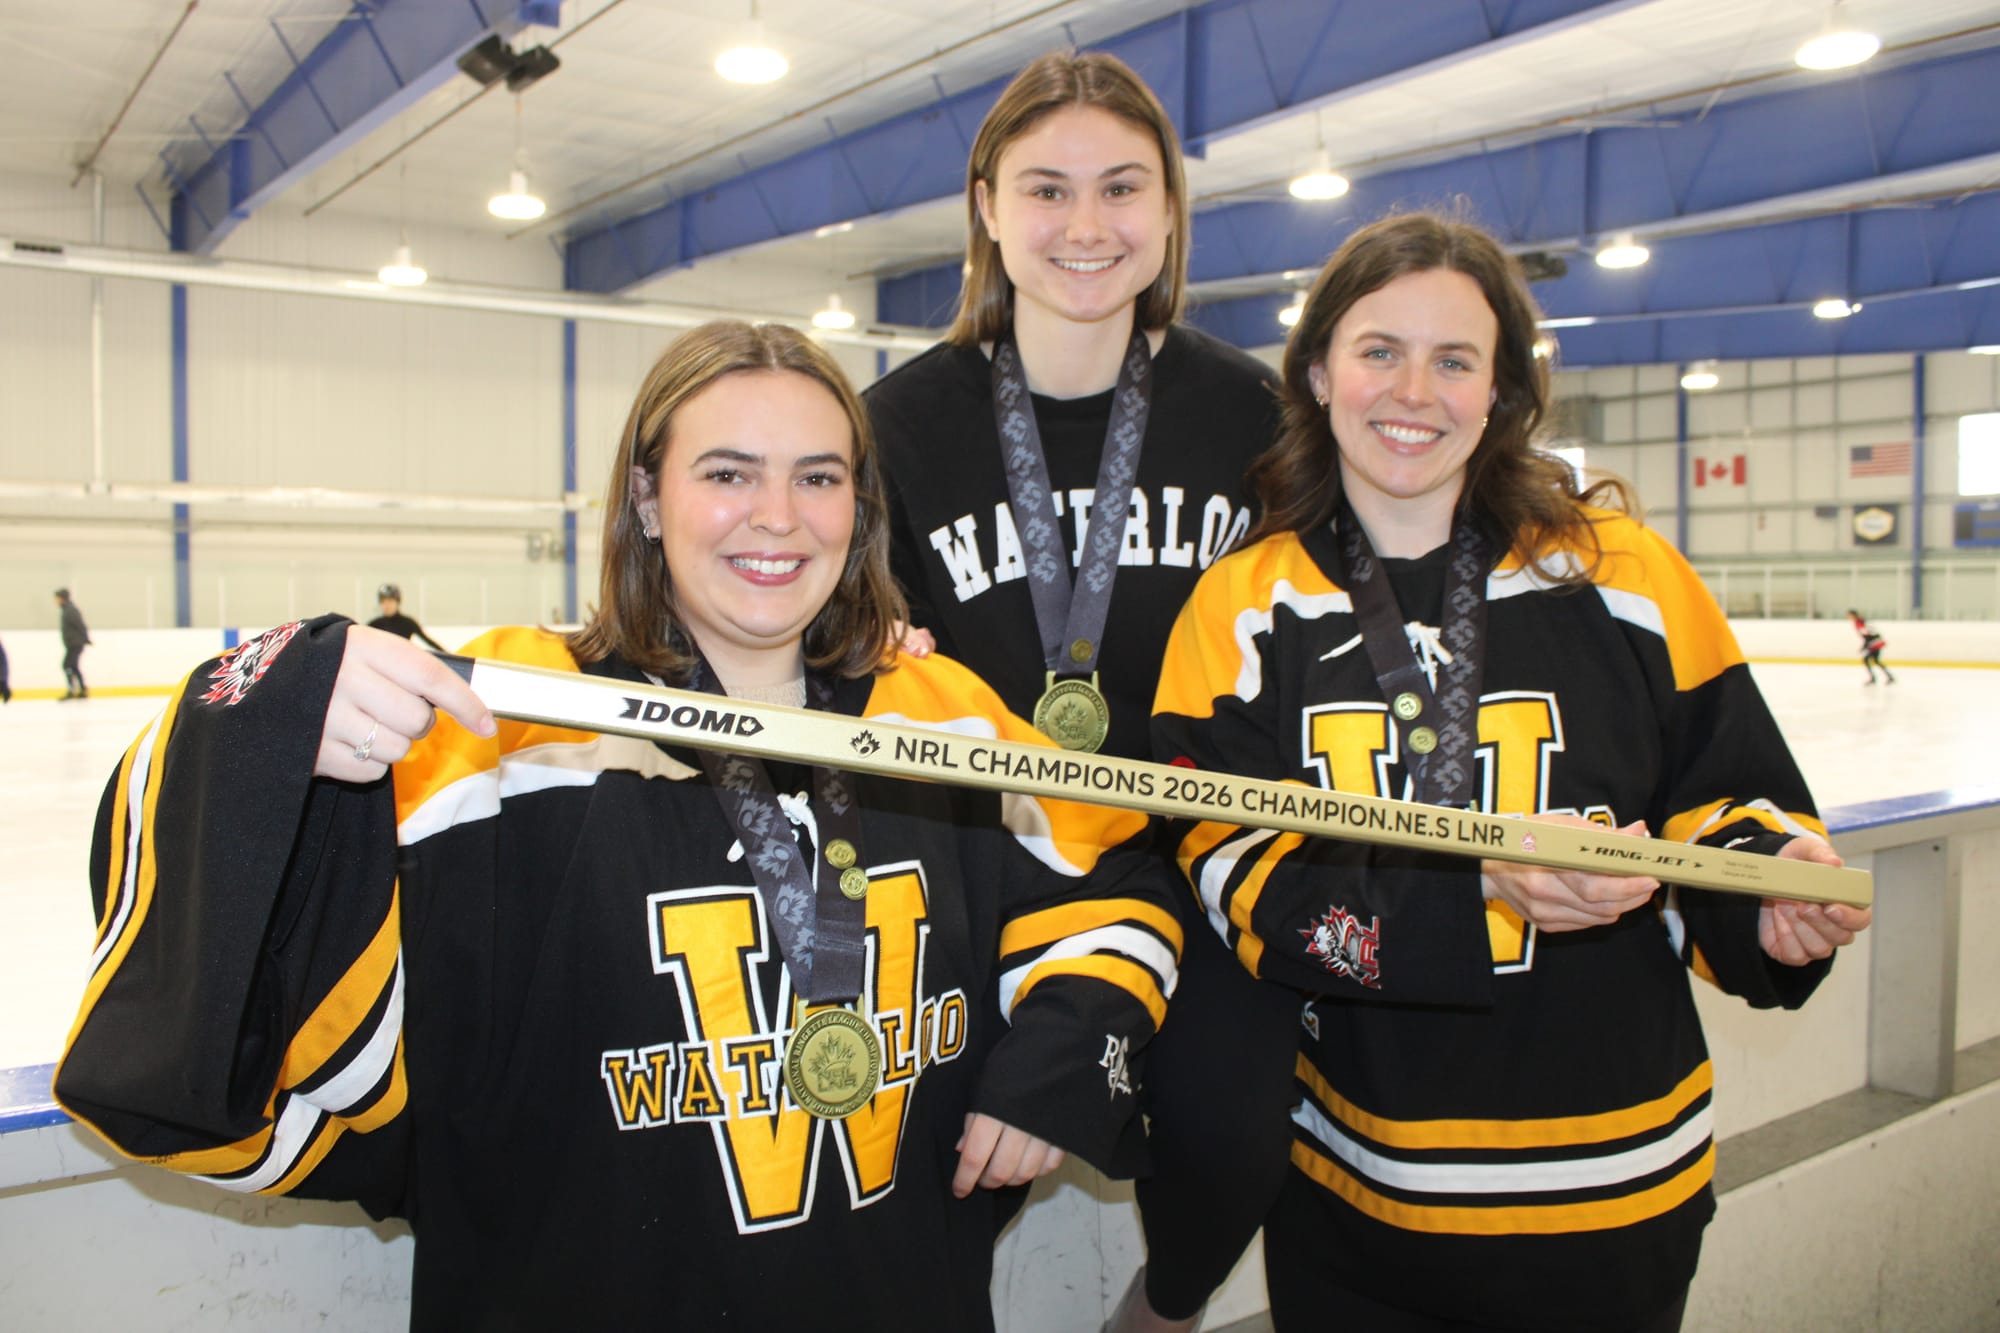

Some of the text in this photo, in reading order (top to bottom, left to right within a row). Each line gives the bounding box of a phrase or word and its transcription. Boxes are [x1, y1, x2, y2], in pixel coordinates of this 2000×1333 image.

[929, 486, 1250, 603] WAERLOO
[894, 736, 1505, 847] NRL CHAMPIONS 2026 CHAMPION.NE.S LNR
[1595, 847, 1685, 867] RING-JET
[601, 988, 968, 1131] WATLOO
[646, 860, 930, 1235] W
